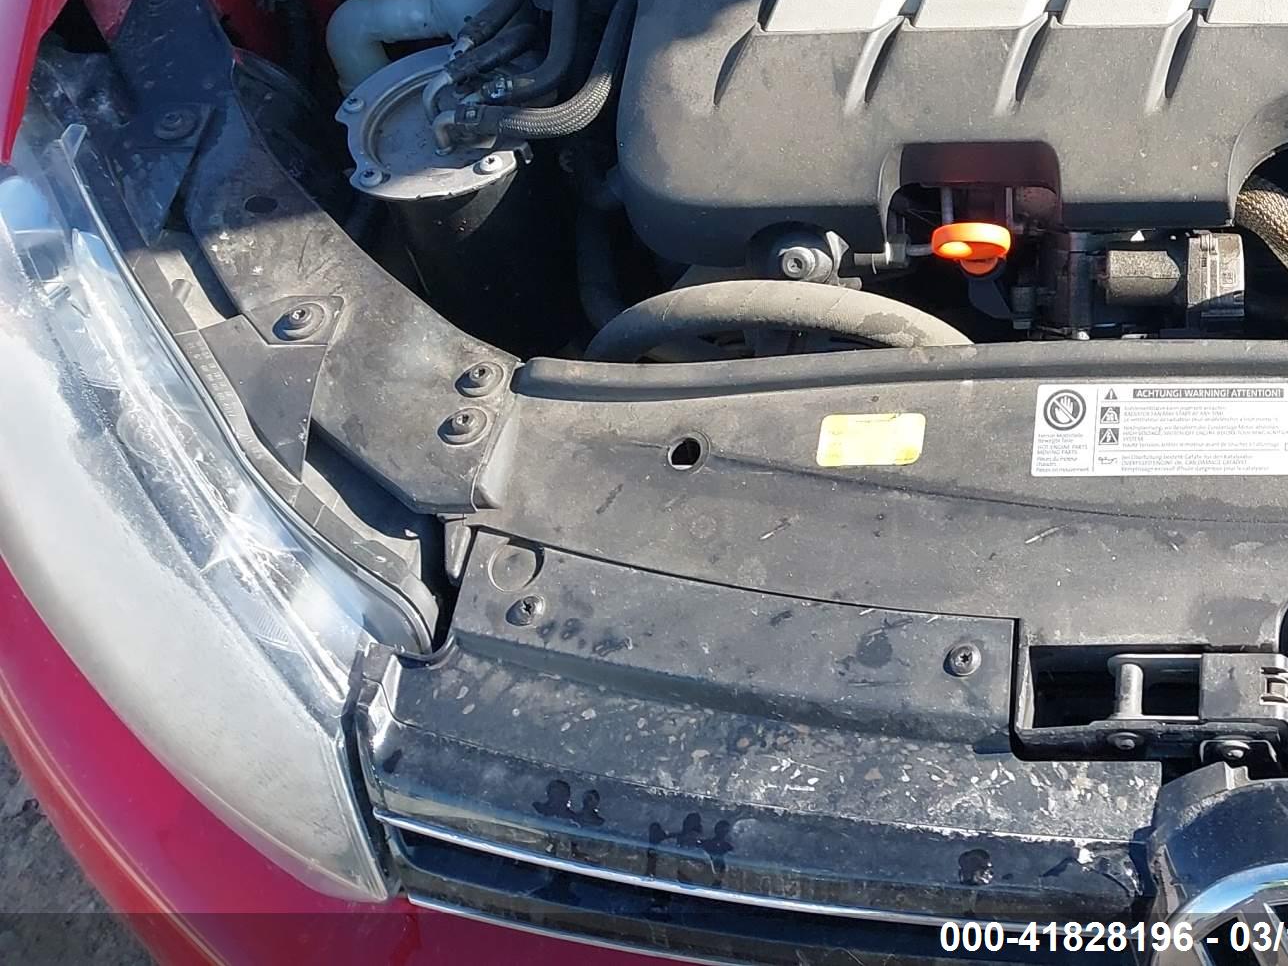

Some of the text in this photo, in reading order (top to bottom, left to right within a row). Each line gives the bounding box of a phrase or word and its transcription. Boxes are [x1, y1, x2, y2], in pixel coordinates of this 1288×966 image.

[1136, 389, 1281, 398] ACHTUNG! WARNING! ATTENTION!
